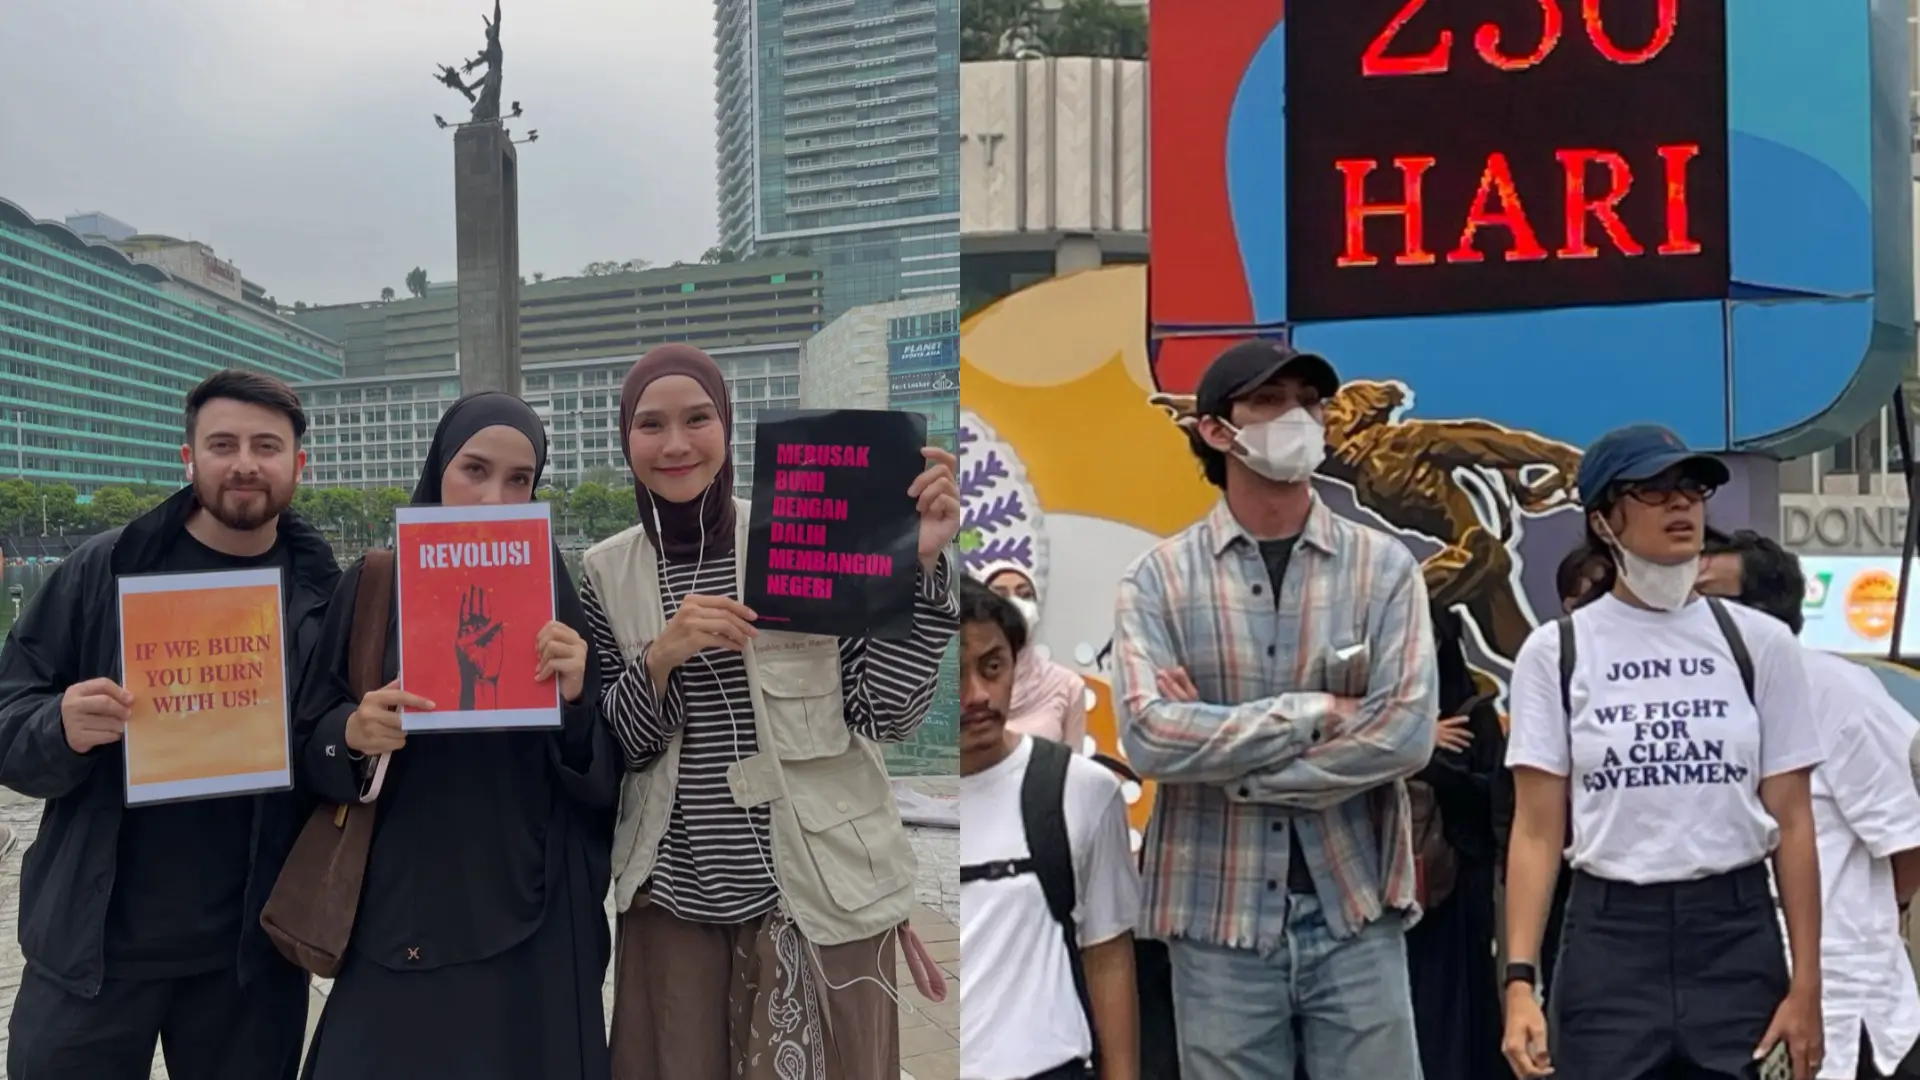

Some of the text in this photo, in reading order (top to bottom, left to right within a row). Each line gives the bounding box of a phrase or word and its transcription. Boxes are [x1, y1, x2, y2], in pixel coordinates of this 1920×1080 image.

[960, 132, 1004, 167] T
[1334, 144, 1702, 268] HARI
[903, 341, 942, 354] PLANET
[776, 443, 870, 467] MERUSAK
[775, 469, 825, 493] BUMI
[772, 495, 848, 520] DENGAN
[770, 521, 827, 546] DALIH
[419, 540, 531, 569] REVOLUSI
[768, 548, 893, 577] MEMBANGUN
[766, 574, 833, 600] NEGERI
[134, 634, 271, 661] IF WE BURN
[144, 662, 263, 687] YOU BURN
[1606, 658, 1716, 681] JOIN US
[152, 688, 258, 714] WITH US!
[1595, 699, 1728, 724] WE FIGHT
[1634, 720, 1690, 741] FOR
[1602, 740, 1724, 767] A CLEAN
